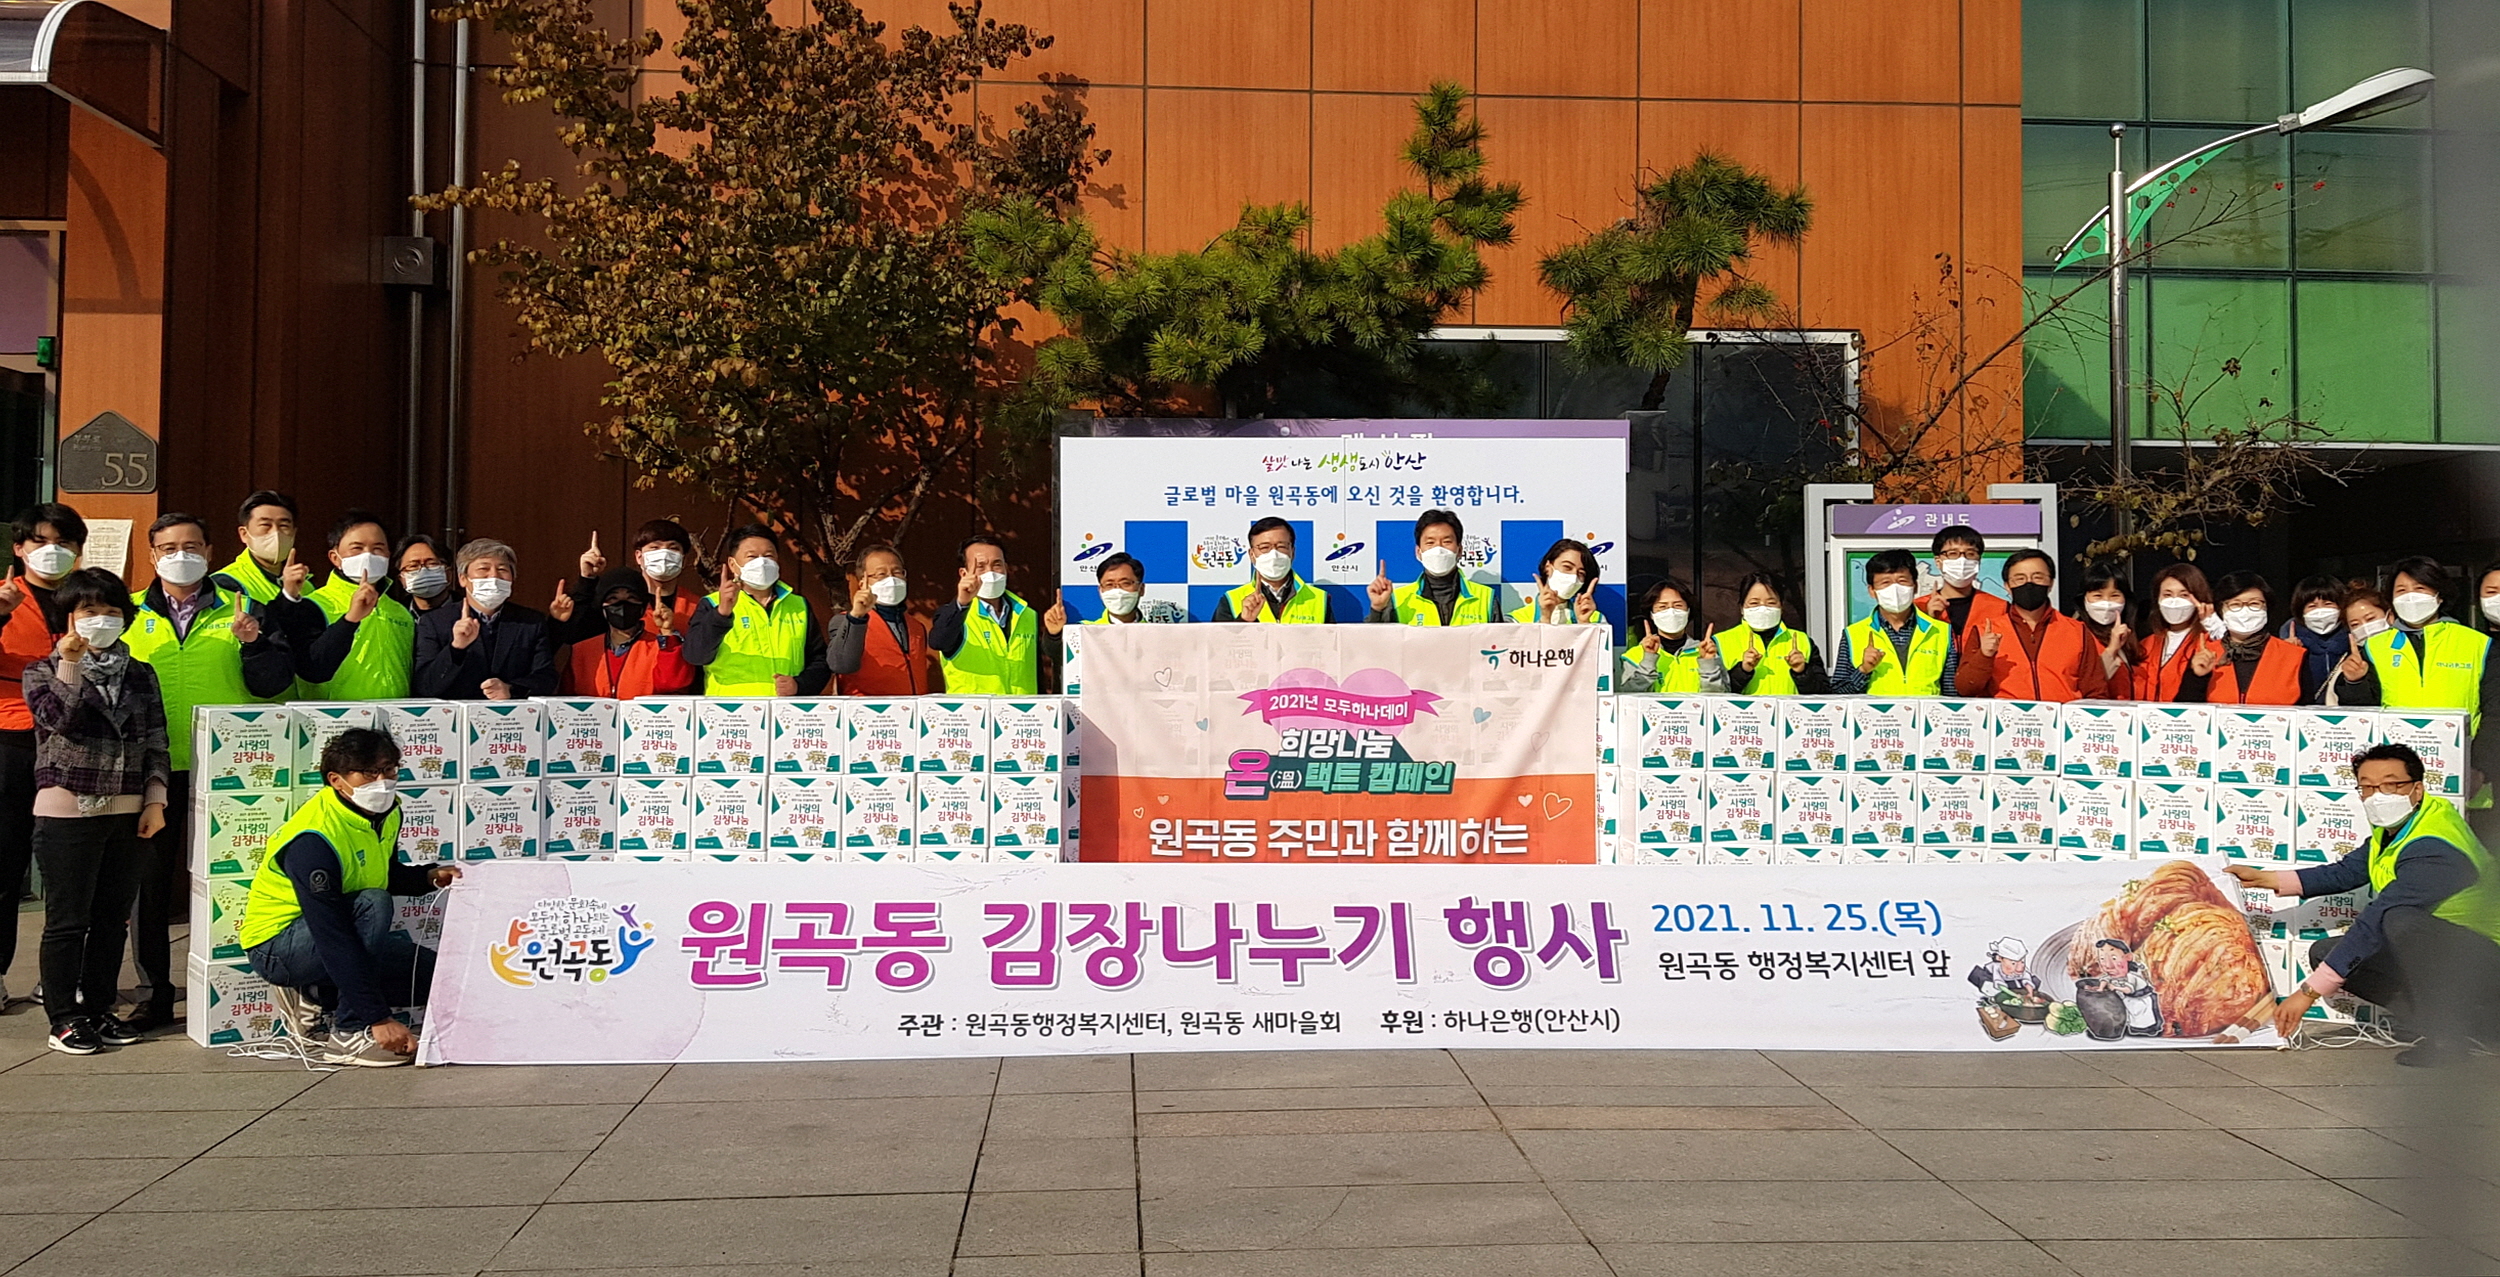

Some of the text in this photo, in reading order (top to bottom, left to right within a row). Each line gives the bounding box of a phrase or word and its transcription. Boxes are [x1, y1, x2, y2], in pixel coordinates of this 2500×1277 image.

[1262, 455, 1289, 472] 살맛
[1291, 456, 1312, 470] 나는
[1384, 450, 1426, 471] 안산
[101, 453, 148, 487] 55
[1164, 485, 1524, 506] 글로벌 마을 원곡동에 오신 것을 환영합니다.
[1925, 513, 1971, 527] 관내도
[1202, 551, 1235, 568] 원곡동
[1331, 564, 1359, 573] 안산시
[1509, 648, 1575, 669] 하나은행
[1269, 693, 1409, 721] 2021년 모두하나데이
[570, 728, 599, 738] 사랑의
[645, 730, 674, 740] 사랑의
[720, 729, 748, 739] 사랑의
[796, 728, 825, 738] 사랑의
[870, 729, 898, 739] 사랑의
[942, 728, 968, 738] 사랑의
[1015, 729, 1042, 739] 사랑의
[1663, 726, 1688, 735] 사랑의
[1733, 725, 1759, 735] 사랑의
[1806, 729, 1831, 738] 사랑의
[1875, 729, 1900, 738] 사랑의
[1945, 727, 1971, 737] 사랑의
[2015, 727, 2041, 737] 사랑의
[407, 733, 439, 744] 사랑의
[493, 732, 523, 743] 사랑의
[938, 738, 972, 748] 김장나눔
[1278, 728, 1394, 758] 희망나눔
[1658, 734, 1692, 745] 김장나눔
[1728, 734, 1764, 745] 김장나눔
[1802, 738, 1836, 748] 김장나눔
[1870, 738, 1904, 748] 김장나눔
[1940, 736, 1976, 747] 김장나눔
[2010, 736, 2046, 747] 김장나눔
[2086, 732, 2116, 743] 사랑의
[2164, 733, 2195, 744] 사랑의
[237, 740, 270, 752] 사랑의
[488, 742, 528, 755] 김장나눔
[566, 738, 604, 749] 김장나눔
[640, 740, 678, 751] 김장나눔
[716, 738, 752, 750] 김장나눔
[792, 738, 830, 749] 김장나눔
[866, 738, 902, 750] 김장나눔
[1010, 738, 1046, 750] 김장나눔
[2082, 742, 2120, 755] 김장나눔
[2241, 738, 2273, 749] 사랑의
[2323, 741, 2353, 752] 사랑의
[402, 744, 444, 756] 김장나눔
[2160, 744, 2200, 756] 김장나눔
[2236, 748, 2278, 761] 김장나눔
[232, 752, 276, 765] 김장나눔
[1368, 761, 1453, 793] 캠페인
[867, 802, 895, 812] 사랑의
[942, 801, 969, 811] 사랑의
[1015, 802, 1042, 812] 사랑의
[1661, 801, 1686, 810] 사랑의
[1731, 798, 1757, 808] 사랑의
[1802, 801, 1828, 811] 사랑의
[1872, 801, 1899, 811] 사랑의
[1943, 800, 1969, 810] 사랑의
[2012, 801, 2038, 811] 사랑의
[567, 805, 597, 816] 사랑의
[642, 805, 670, 815] 사랑의
[717, 805, 745, 815] 사랑의
[793, 804, 821, 814] 사랑의
[1726, 808, 1762, 818] 김장나눔
[2081, 805, 2109, 815] 사랑의
[2162, 808, 2193, 819] 사랑의
[404, 815, 436, 826] 사랑의
[489, 812, 520, 823] 사랑의
[638, 814, 674, 826] 김장나눔
[712, 814, 750, 826] 김장나눔
[788, 814, 826, 825] 김장나눔
[862, 812, 900, 823] 김장나눔
[938, 810, 974, 822] 김장나눔
[1010, 812, 1046, 823] 김장나눔
[1656, 810, 1690, 820] 김장나눔
[1798, 810, 1832, 821] 김장나눔
[1868, 810, 1904, 822] 김장나눔
[1938, 810, 1974, 820] 김장나눔
[2008, 810, 2042, 821] 김장나눔
[2076, 814, 2114, 826] 김장나눔
[2239, 813, 2271, 824] 사랑의
[562, 816, 602, 828] 김장나눔
[2158, 818, 2198, 831] 김장나눔
[2322, 816, 2353, 828] 사랑의
[236, 823, 269, 835] 사랑의
[400, 826, 440, 838] 김장나눔
[484, 822, 524, 835] 김장나눔
[2234, 824, 2276, 836] 김장나눔
[2316, 828, 2358, 840] 김장나눔
[1148, 818, 1529, 858] 원곡동 주민과 함께하는
[2323, 897, 2353, 907] 사랑의
[2244, 902, 2274, 914] 장나눔
[1651, 900, 1942, 937] 2021. 11. 25.(목)
[538, 924, 605, 940] 글로벌 공동체
[681, 896, 1625, 989] 원곡동 김장나누기 행사
[522, 938, 613, 982] 원곡동
[1658, 950, 1951, 980] 원곡동 행정복지센터 앞
[236, 990, 268, 1002] 사랑의
[230, 1003, 274, 1016] 김장나눔
[897, 1014, 943, 1036] 주관
[965, 1012, 1172, 1038] 원곡동행정복지센터,
[1179, 1011, 1245, 1035] 원곡동
[1252, 1010, 1341, 1034] 새마을회
[1380, 1010, 1424, 1034] 후원
[1443, 1007, 1621, 1034] 하나은행(안산시)
